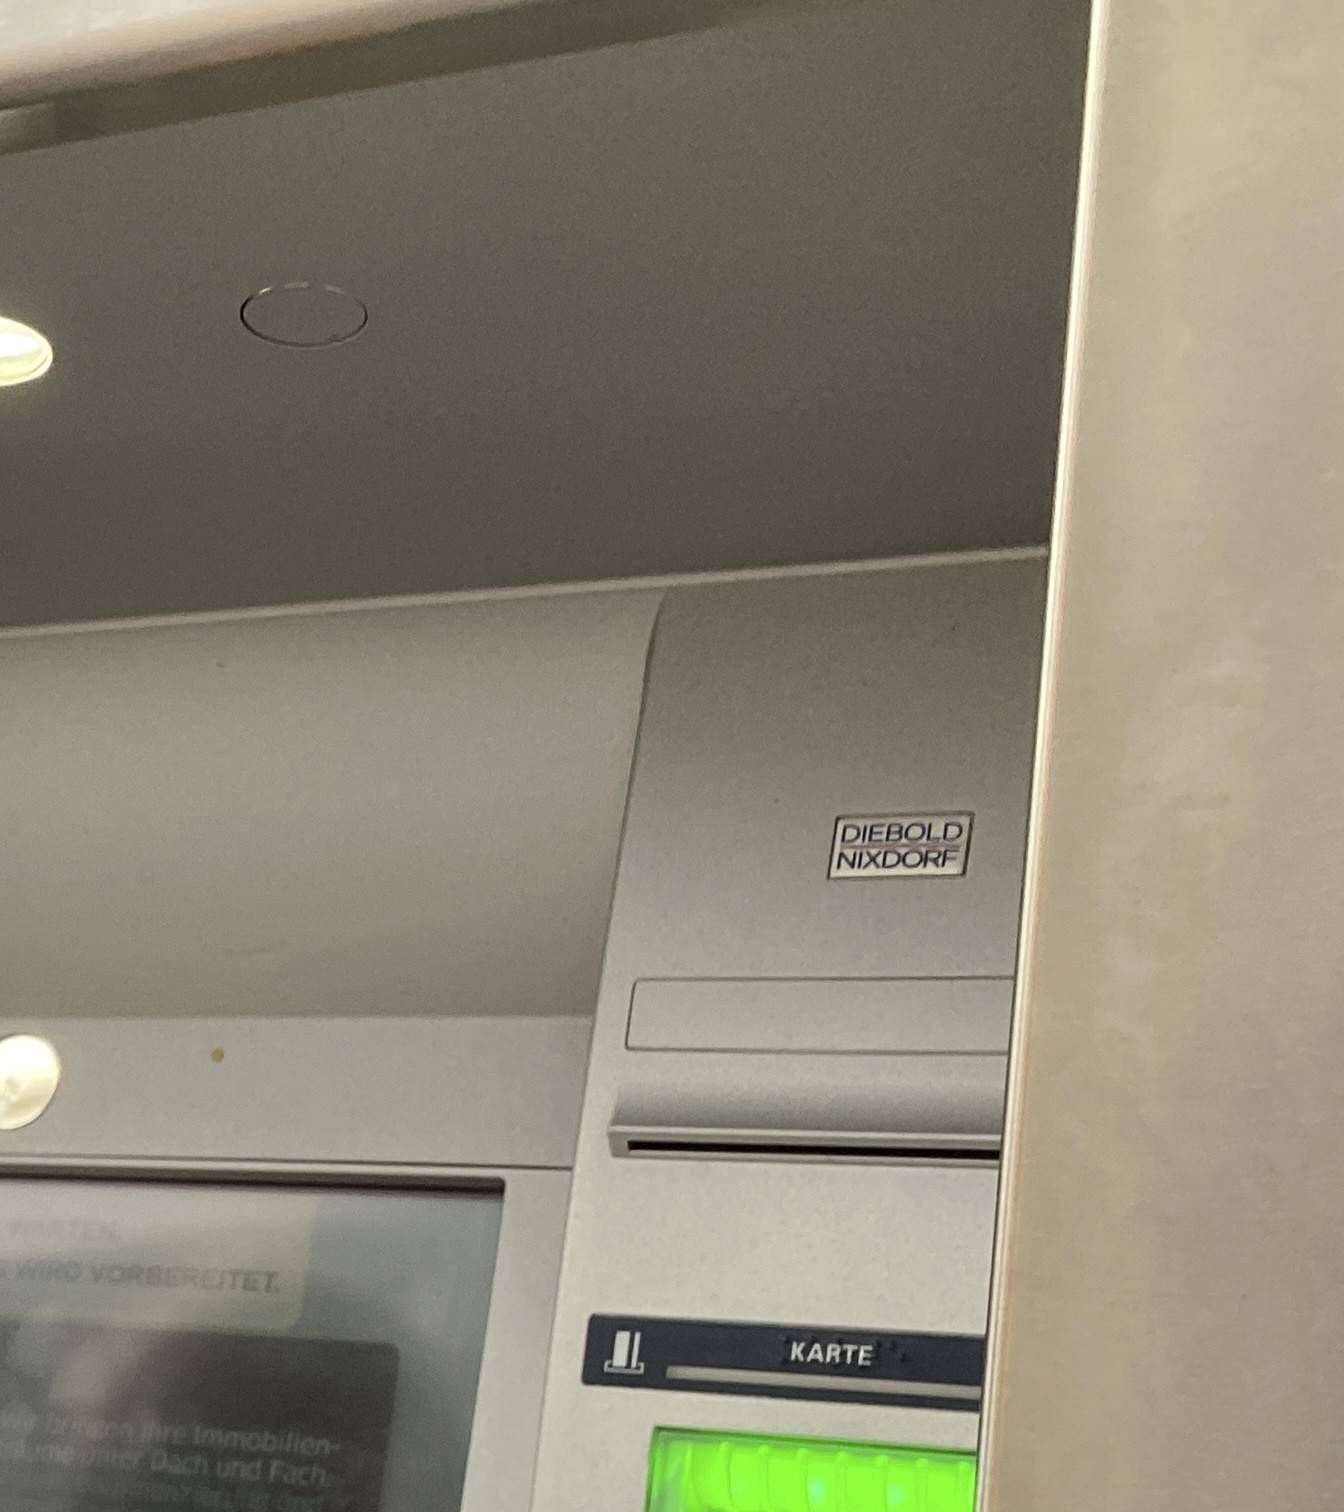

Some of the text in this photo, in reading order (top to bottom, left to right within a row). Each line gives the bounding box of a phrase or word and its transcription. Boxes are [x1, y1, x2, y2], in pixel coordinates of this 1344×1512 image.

[840, 821, 963, 844] DIEBOLD
[836, 849, 961, 870] NIXDORF
[790, 1340, 874, 1367] KARTE
[193, 1423, 341, 1457] Immobilien-
[150, 1452, 208, 1476] Dach
[216, 1458, 261, 1482] und
